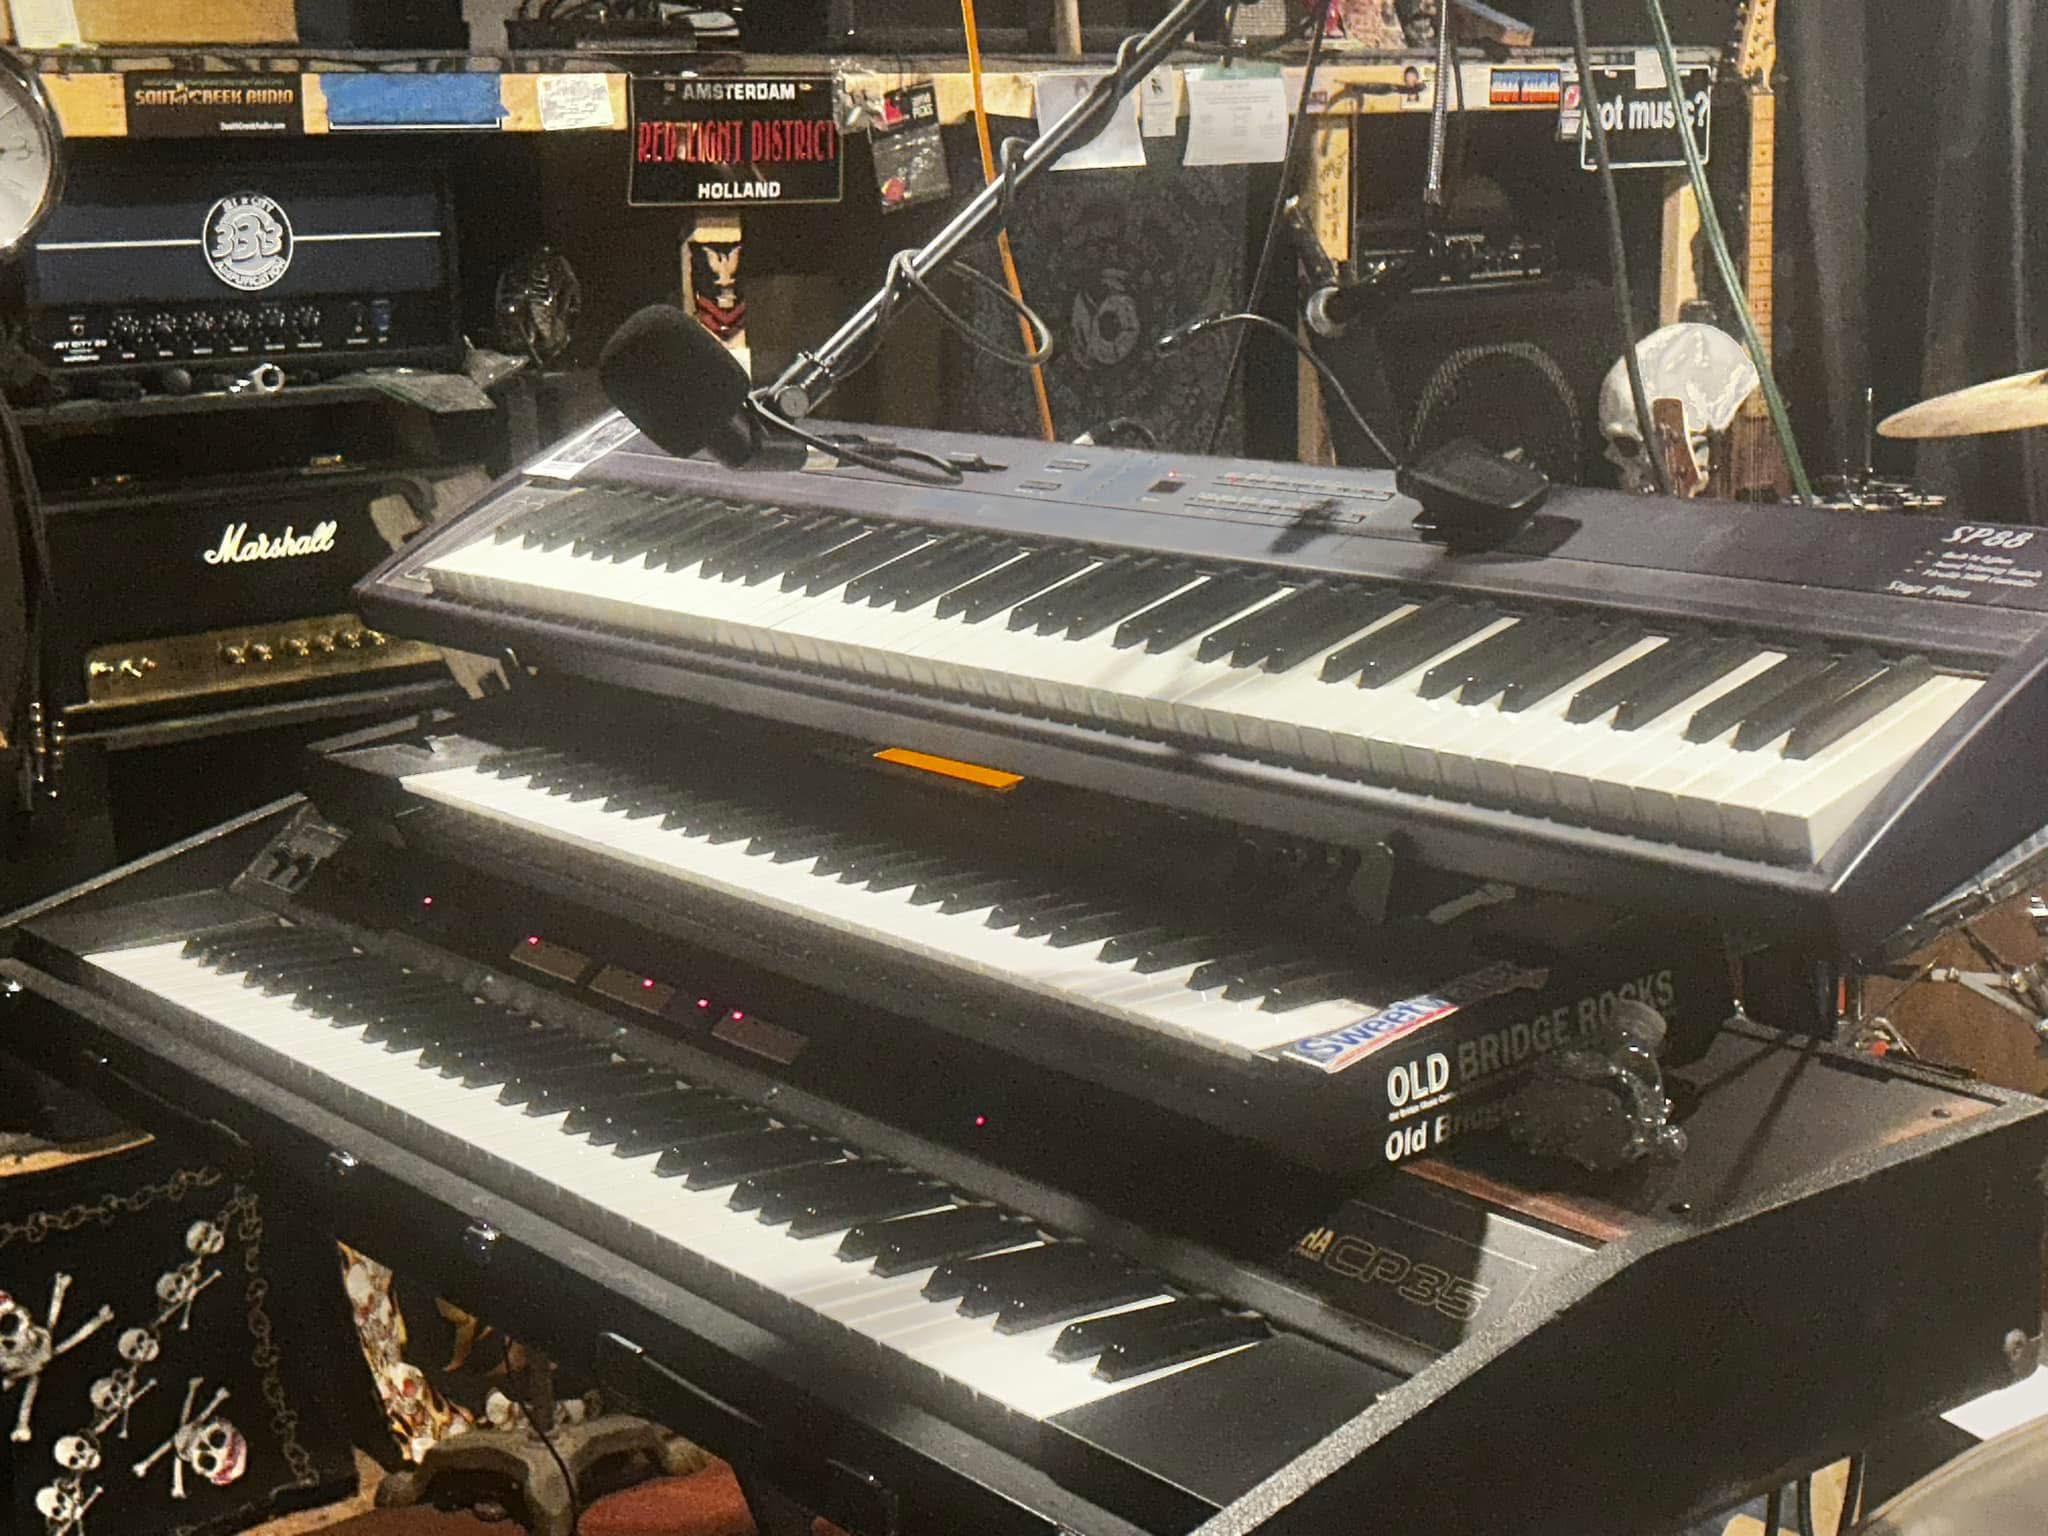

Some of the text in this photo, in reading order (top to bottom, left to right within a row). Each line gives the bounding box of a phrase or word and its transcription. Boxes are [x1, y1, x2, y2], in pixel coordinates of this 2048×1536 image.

[245, 89, 294, 105] AUDIO
[682, 83, 796, 100] AMSTERDAM
[1628, 90, 1708, 130] musc?
[638, 119, 838, 164] RED LIGHT DISTRICT
[697, 181, 782, 200] HOLLAND
[203, 520, 338, 565] Marshall
[1940, 525, 2035, 549] SP88
[1387, 1052, 1450, 1107] OLD
[1458, 1006, 1572, 1081] BRIDGE
[1384, 1120, 1428, 1162] Old
[1324, 1235, 1491, 1320] CP35
